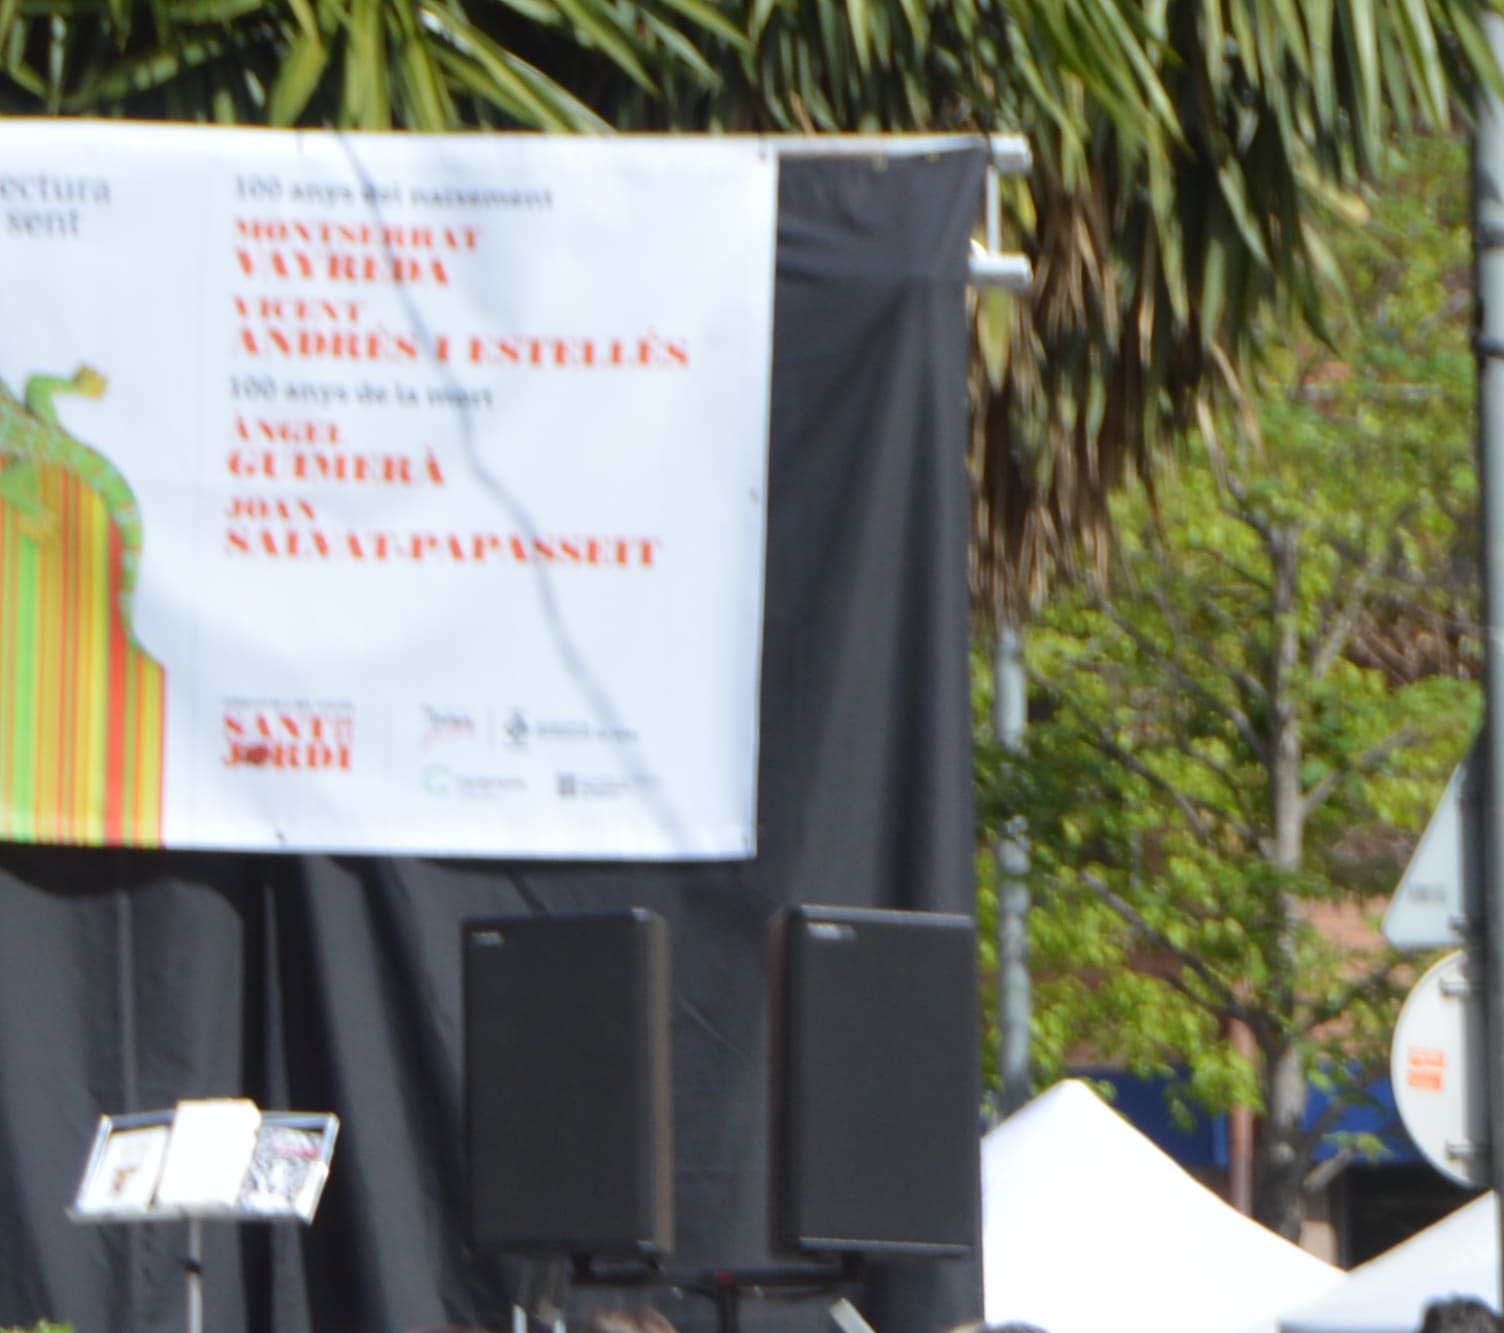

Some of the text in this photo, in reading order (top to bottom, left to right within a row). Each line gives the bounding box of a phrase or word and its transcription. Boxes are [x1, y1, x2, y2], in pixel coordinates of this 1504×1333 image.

[236, 176, 283, 202] 100
[289, 182, 354, 208] anys
[411, 186, 554, 211] naixement
[234, 219, 481, 251] MONTSERRAT
[234, 248, 449, 285] VAYREDA
[234, 295, 360, 322] VICENT
[236, 324, 419, 358] ANDRÉS
[467, 327, 689, 365] ESTELLÉS
[230, 377, 494, 409] 100 anys de la mort
[231, 411, 341, 445] ÀNGEL
[226, 443, 445, 486] GUIMERÀ
[225, 498, 317, 521] JOAN
[226, 530, 657, 568] SALVAT-PAPASSEIT
[223, 712, 326, 738] SANT
